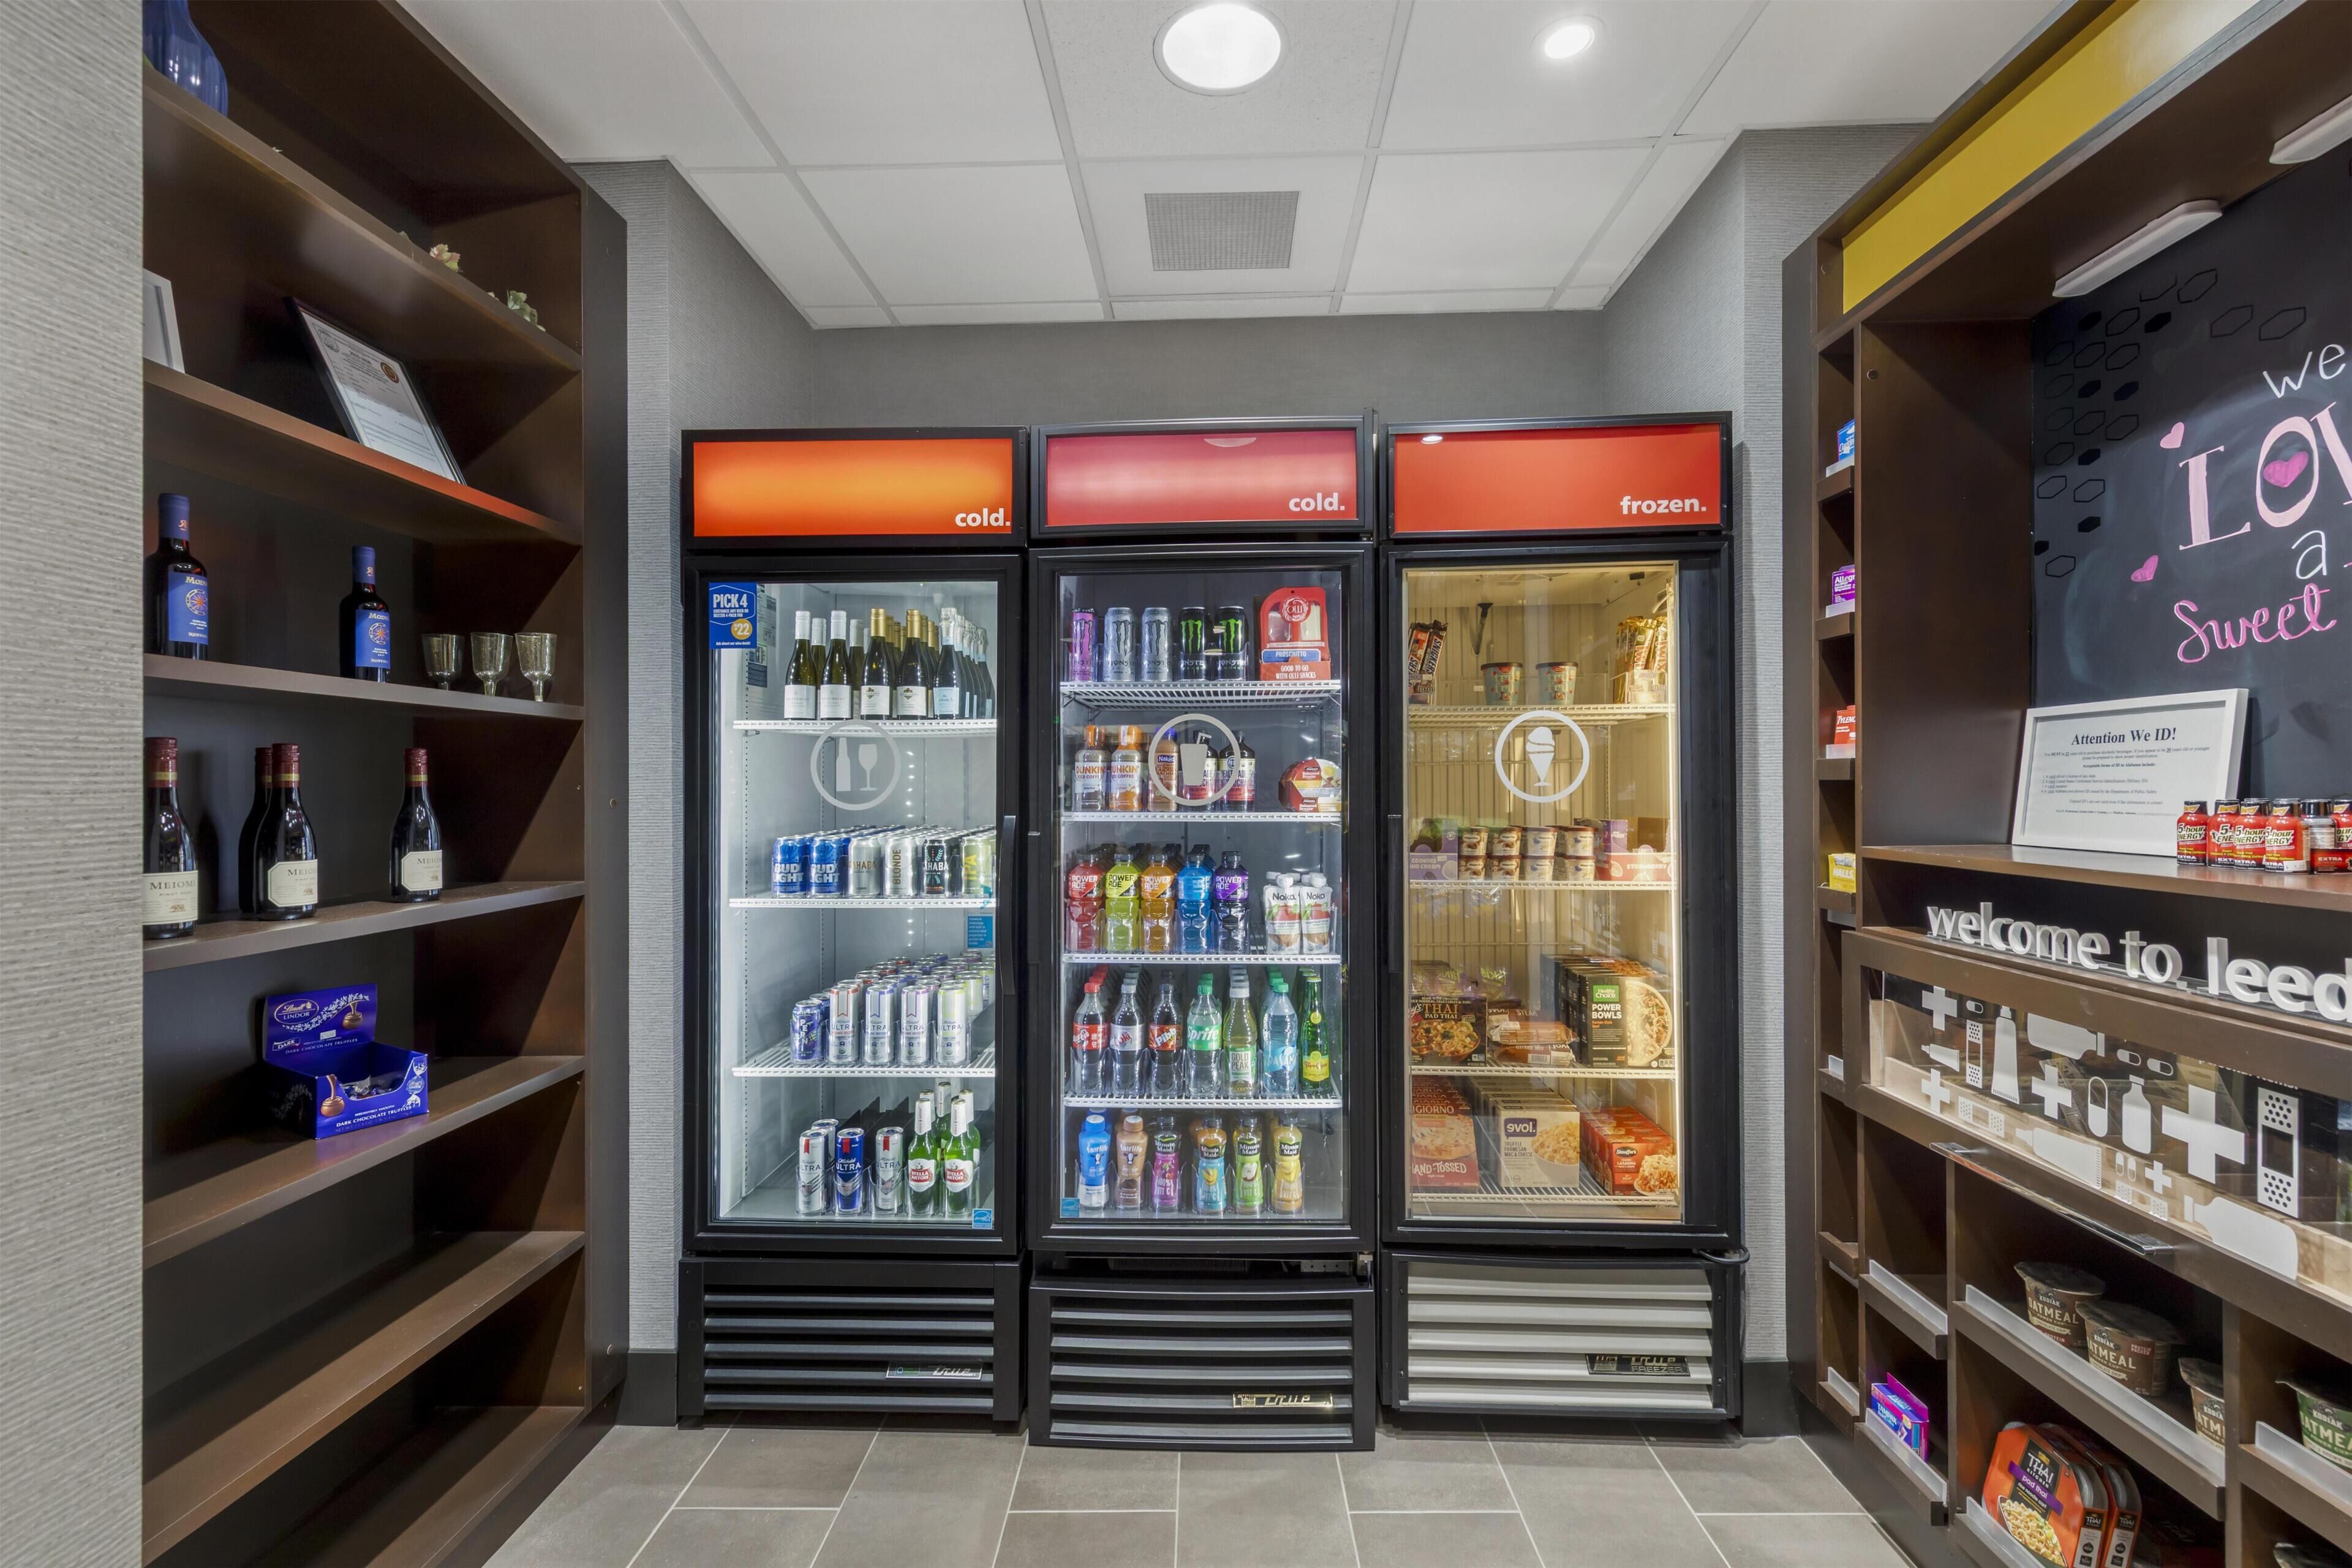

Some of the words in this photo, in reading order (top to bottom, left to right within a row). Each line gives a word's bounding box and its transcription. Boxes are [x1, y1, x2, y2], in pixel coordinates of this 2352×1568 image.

[2263, 344, 2346, 398] we
[1288, 492, 1346, 511] cold.
[1619, 496, 1706, 515] frozen.
[954, 508, 1011, 527] cold.
[2292, 530, 2327, 579] a
[713, 594, 739, 608] PICK
[739, 594, 748, 608] 4
[2174, 582, 2337, 663] Sweet
[1427, 638, 1442, 674] SNICKERS
[2071, 732, 2125, 745] Attention
[2130, 729, 2150, 742] We
[2154, 727, 2176, 741] ID!
[2179, 824, 2205, 833] 5-hour
[2236, 826, 2264, 835] 5-hour
[2235, 835, 2264, 844] ENERGY
[2266, 837, 2292, 845] NERGY
[774, 863, 800, 873] BUD
[892, 849, 902, 884] BLONDE
[924, 862, 949, 870] AHABA
[810, 873, 840, 883] IGHT
[149, 880, 197, 891] MEIOMI
[1272, 892, 1296, 901] Noka
[1926, 902, 2111, 969] welcome
[2119, 930, 2183, 982] to
[283, 1011, 310, 1020] LINDOR
[1422, 1004, 1458, 1014] THAI
[1188, 1026, 1219, 1041] Sprite
[277, 1039, 295, 1050] DARK
[301, 1042, 333, 1051] CHOCOLATE
[1231, 1053, 1249, 1061] GOLD
[1231, 1061, 1249, 1069] PEAK
[353, 1112, 386, 1123] CHOCOLATE
[387, 1106, 412, 1117] TRUFFLES
[1412, 1104, 1454, 1114] IGIORNO
[1507, 1121, 1536, 1133] evol.
[1120, 1144, 1143, 1153] fairlife
[835, 1162, 862, 1170] ULTRA
[2039, 1295, 2061, 1308] KODIAK
[2028, 1296, 2079, 1324] OATMEAL
[2094, 1335, 2115, 1349] KODIAK
[1877, 1402, 1897, 1425] TAMPAX
[2203, 1406, 2225, 1420] KODIA
[2312, 1409, 2344, 1430] KODIAK
[2028, 1452, 2054, 1484] THAI
[2026, 1468, 2049, 1488] KITCHEN
[2022, 1474, 2035, 1488] pad
[2035, 1484, 2048, 1498] thai
[2086, 1515, 2101, 1525] THAI
[2119, 1517, 2135, 1526] THAI
